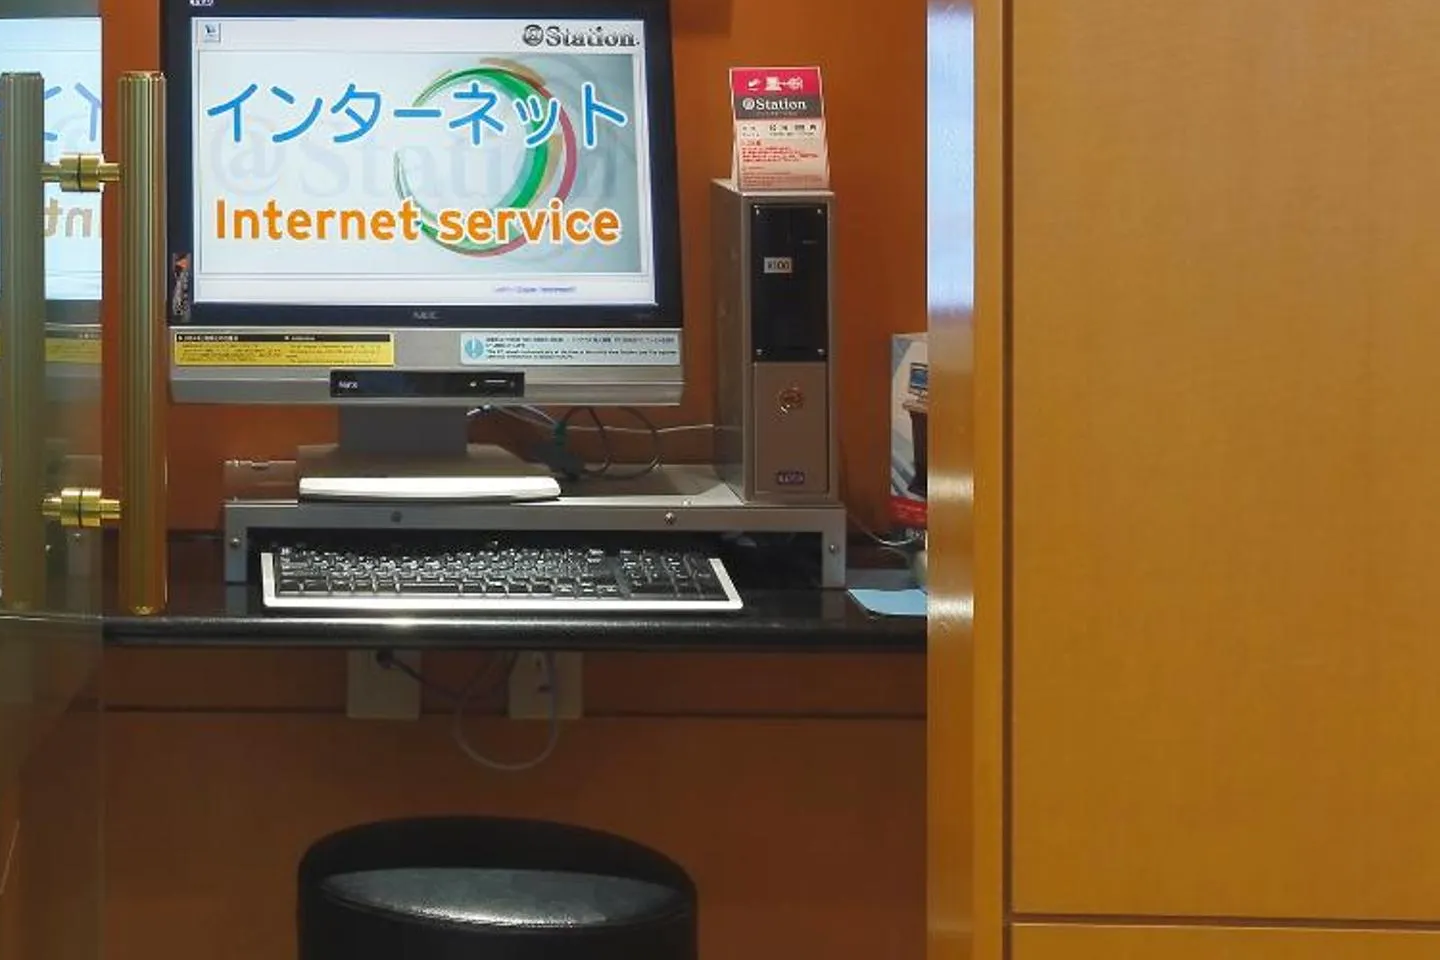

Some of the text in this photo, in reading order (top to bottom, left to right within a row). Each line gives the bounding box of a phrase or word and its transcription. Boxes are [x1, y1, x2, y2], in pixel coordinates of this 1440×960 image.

[206, 82, 628, 147] インターネット
[742, 97, 807, 111] @Station
[214, 198, 621, 243] Internet service
